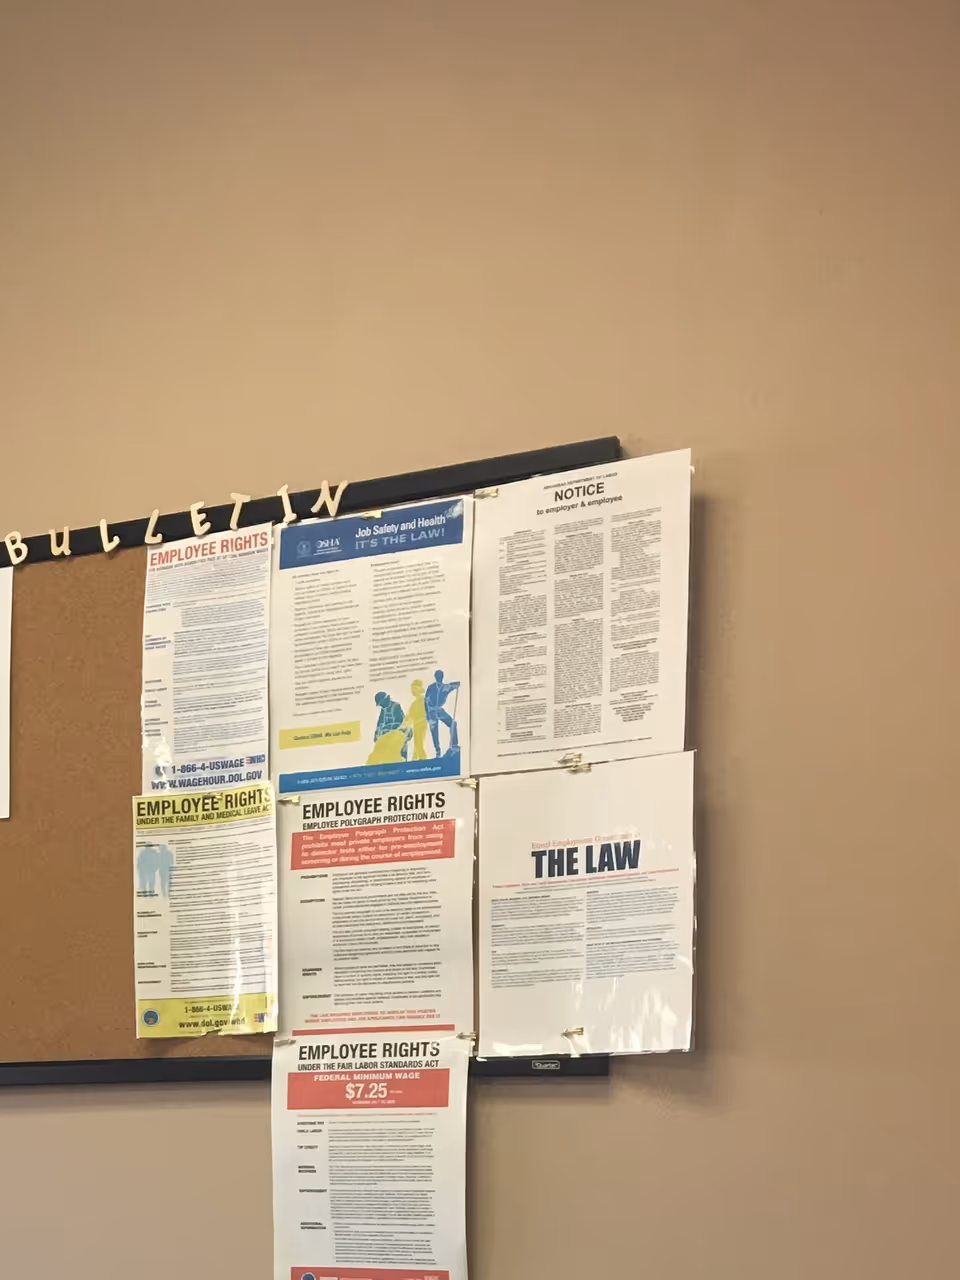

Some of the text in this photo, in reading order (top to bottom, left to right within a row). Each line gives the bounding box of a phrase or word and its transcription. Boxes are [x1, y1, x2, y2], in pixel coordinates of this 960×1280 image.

[554, 482, 605, 502] NOTICE
[545, 502, 579, 515] employer
[588, 494, 623, 507] employee
[4, 480, 348, 565] BULLETIN
[356, 514, 446, 538] Job Safety and Health
[150, 532, 268, 566] EMPLOYEE RIGHTS
[356, 528, 445, 550] IT'S THE LAW!
[172, 758, 244, 774] 1-866-4-USWAGE
[137, 787, 270, 817] EMPLOYEE RIGHTS
[302, 792, 446, 820] EMPLOYEE RIGHTS
[136, 818, 160, 826] UNDER
[176, 814, 200, 824] FAMILY
[201, 812, 215, 820] AND
[216, 809, 242, 820] MEDICAL
[244, 806, 261, 816] LEAVE
[302, 810, 445, 831] EMPLOYEE POLYGRAPH PROTECTION ACT
[392, 825, 426, 834] Protection
[531, 847, 579, 878] THE
[586, 840, 641, 874] LAW
[184, 1003, 239, 1014] 1-866-4-USWA
[298, 1041, 440, 1060] EMPLOYEE RIGHTS
[298, 1060, 440, 1072] UNDER THE FAIR LABOR STANDARDS ACT
[314, 1072, 420, 1082] FEDERAL MINIMUM WAGE
[345, 1082, 388, 1100] $7.25
